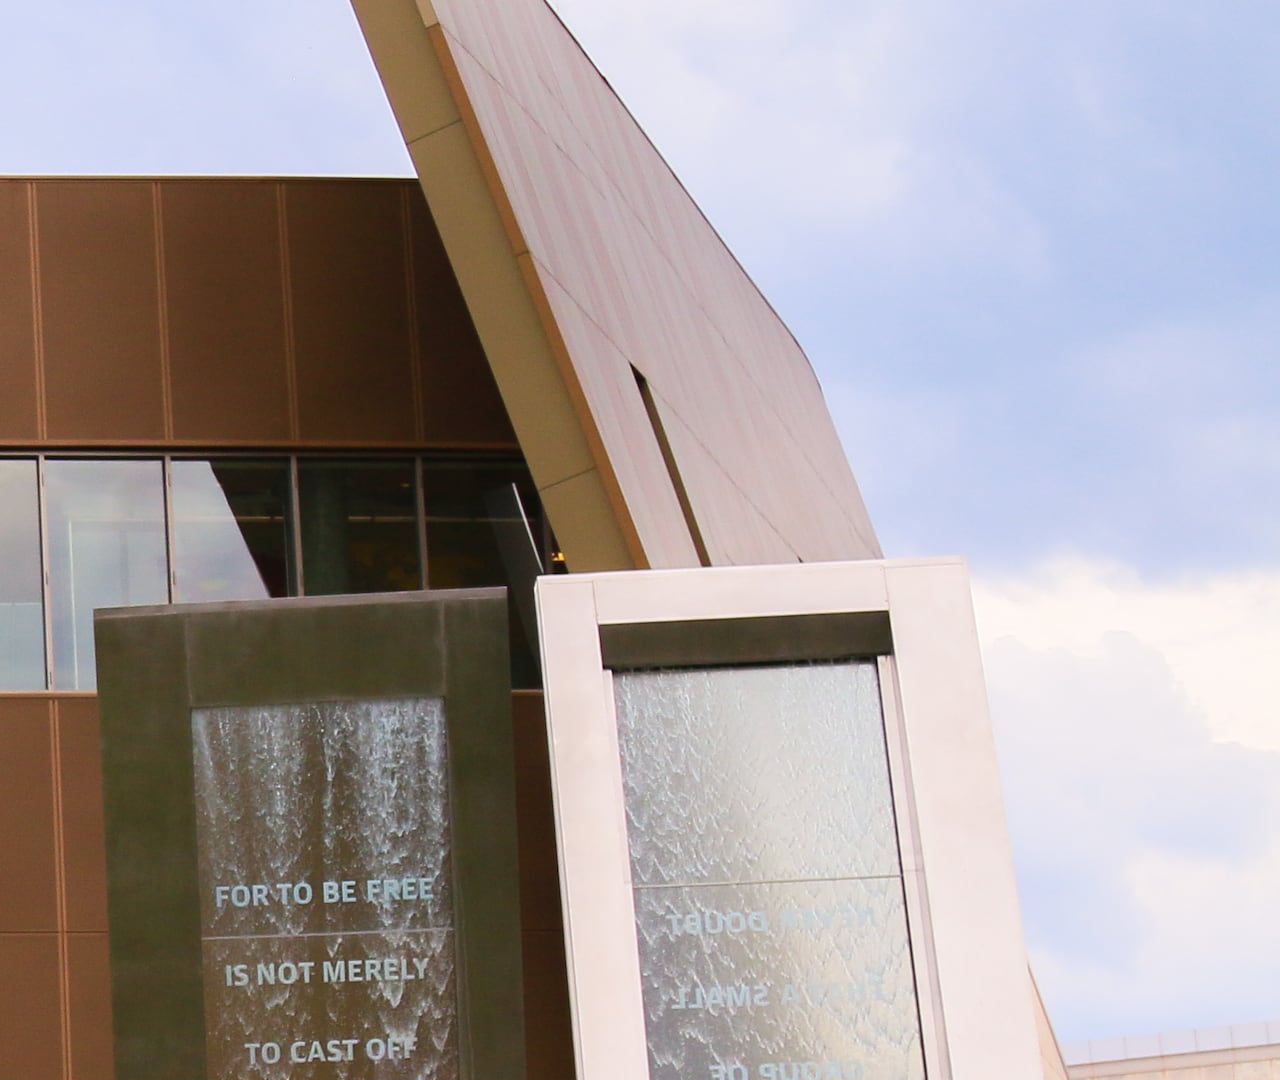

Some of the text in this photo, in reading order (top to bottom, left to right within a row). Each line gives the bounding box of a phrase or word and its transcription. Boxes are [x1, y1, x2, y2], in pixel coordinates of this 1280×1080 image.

[215, 877, 434, 907] FOR TO BE FREE
[225, 957, 429, 986] IS NOT MERELY
[244, 1037, 418, 1065] TO CAST OFF
